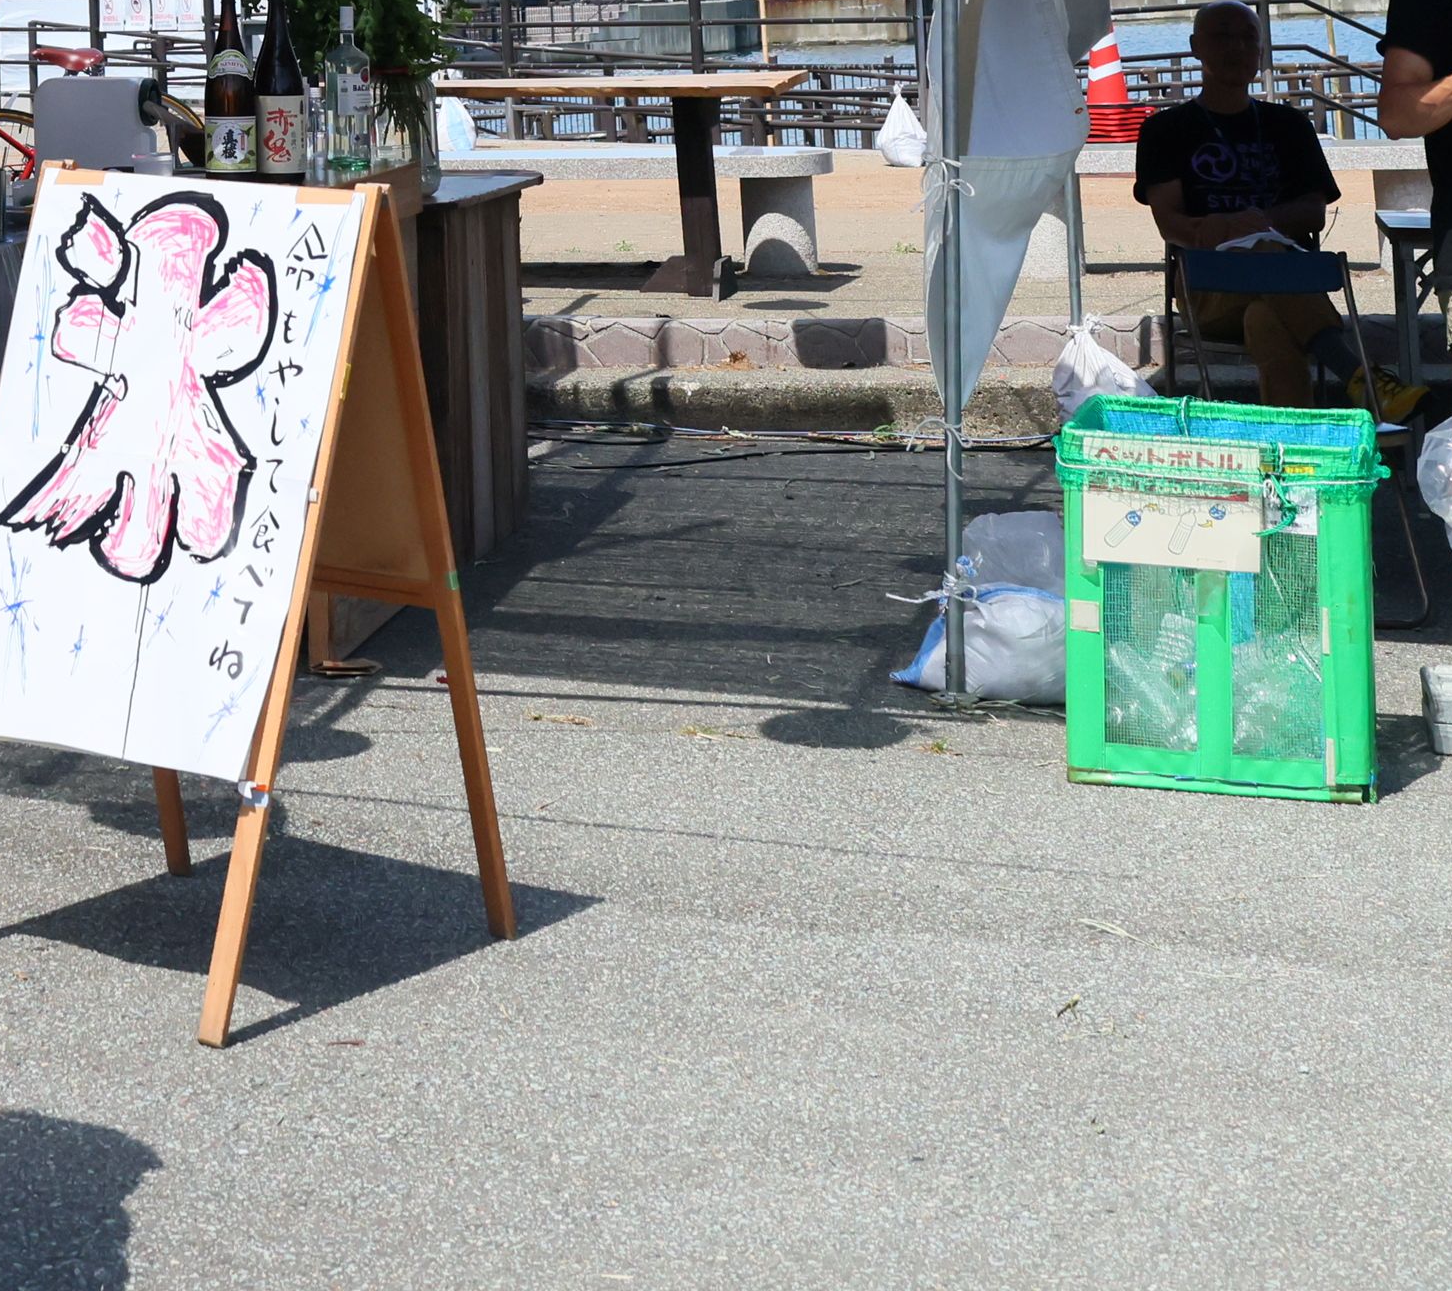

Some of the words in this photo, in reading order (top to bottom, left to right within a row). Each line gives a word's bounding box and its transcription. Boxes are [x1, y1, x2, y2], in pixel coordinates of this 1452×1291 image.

[208, 221, 329, 681] 命もやして食べてね
[1095, 445, 1243, 471] ペットボトル
